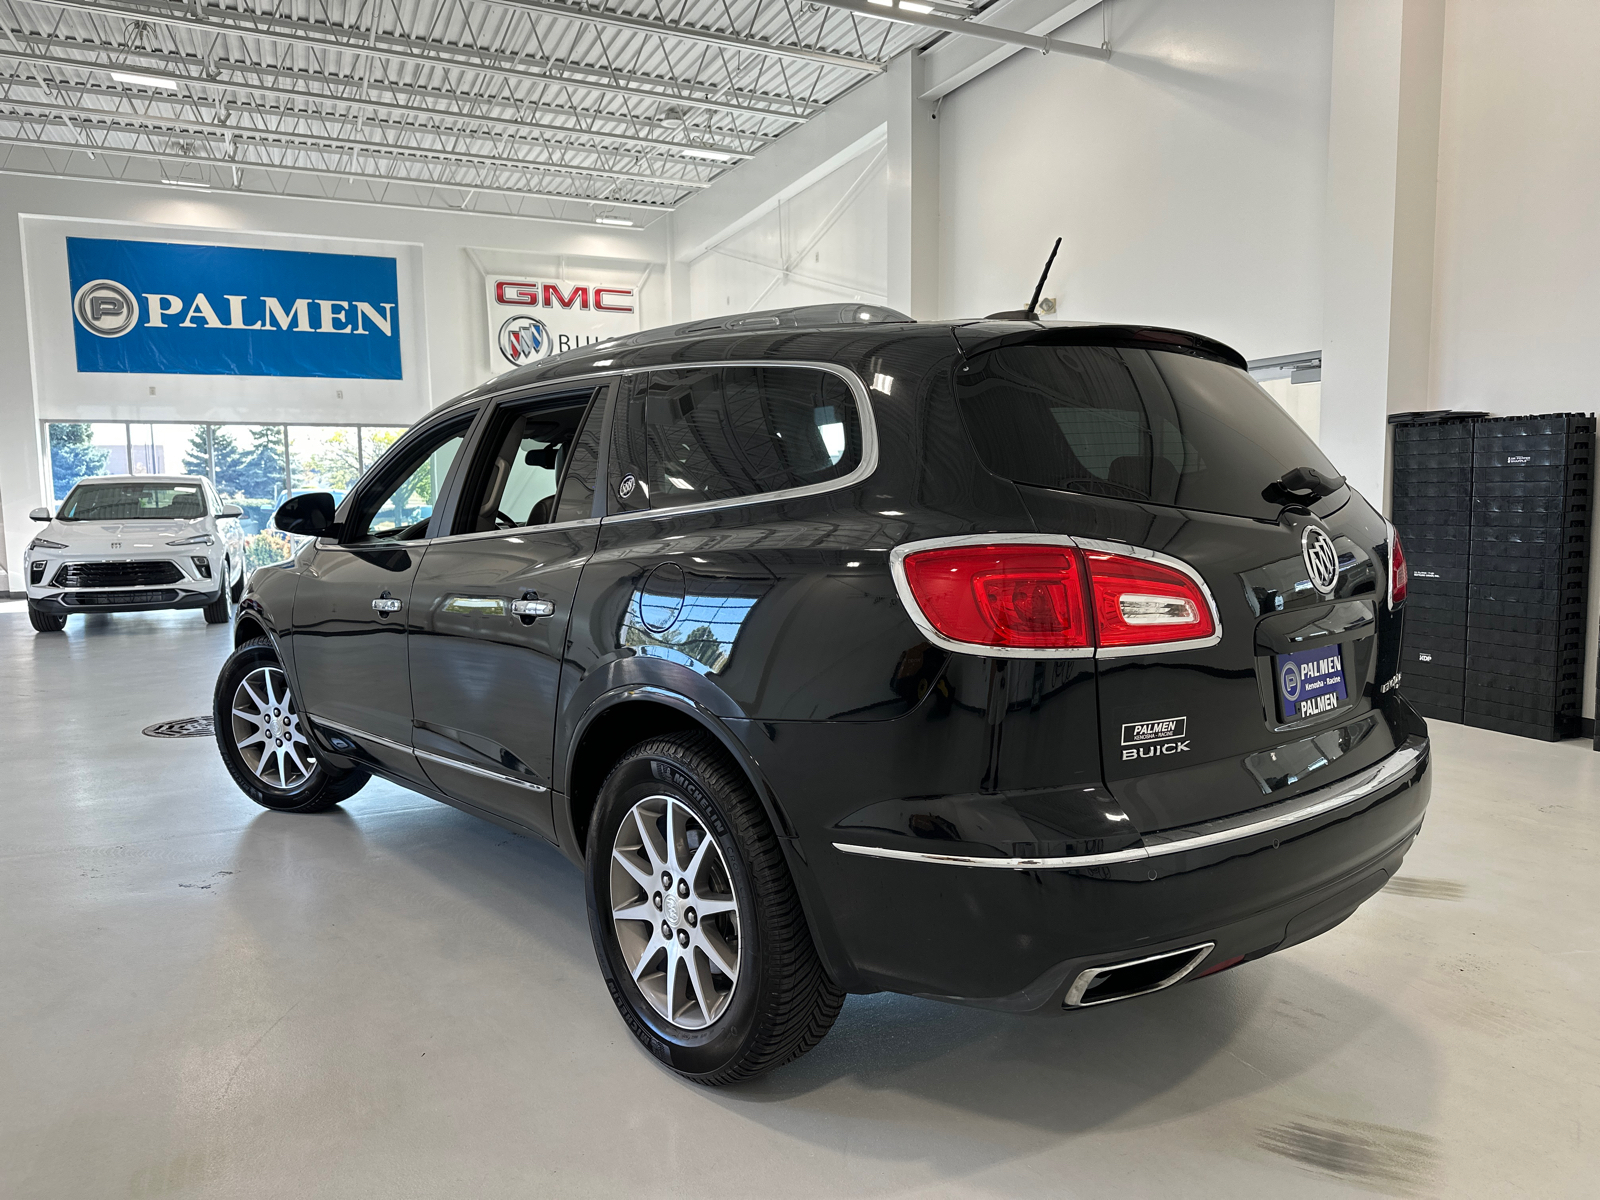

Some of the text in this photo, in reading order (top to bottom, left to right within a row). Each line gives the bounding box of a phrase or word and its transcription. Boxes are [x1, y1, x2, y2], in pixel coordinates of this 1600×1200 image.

[495, 279, 634, 314] GMC
[142, 293, 396, 337] PALMEN
[1301, 656, 1341, 680] PALMEN
[1305, 676, 1341, 691] Kenosha Racine
[1301, 693, 1337, 718] PALMEN
[1134, 721, 1176, 735] PALMEN
[1122, 740, 1191, 760] BUICK
[673, 772, 725, 833] MICHELIN
